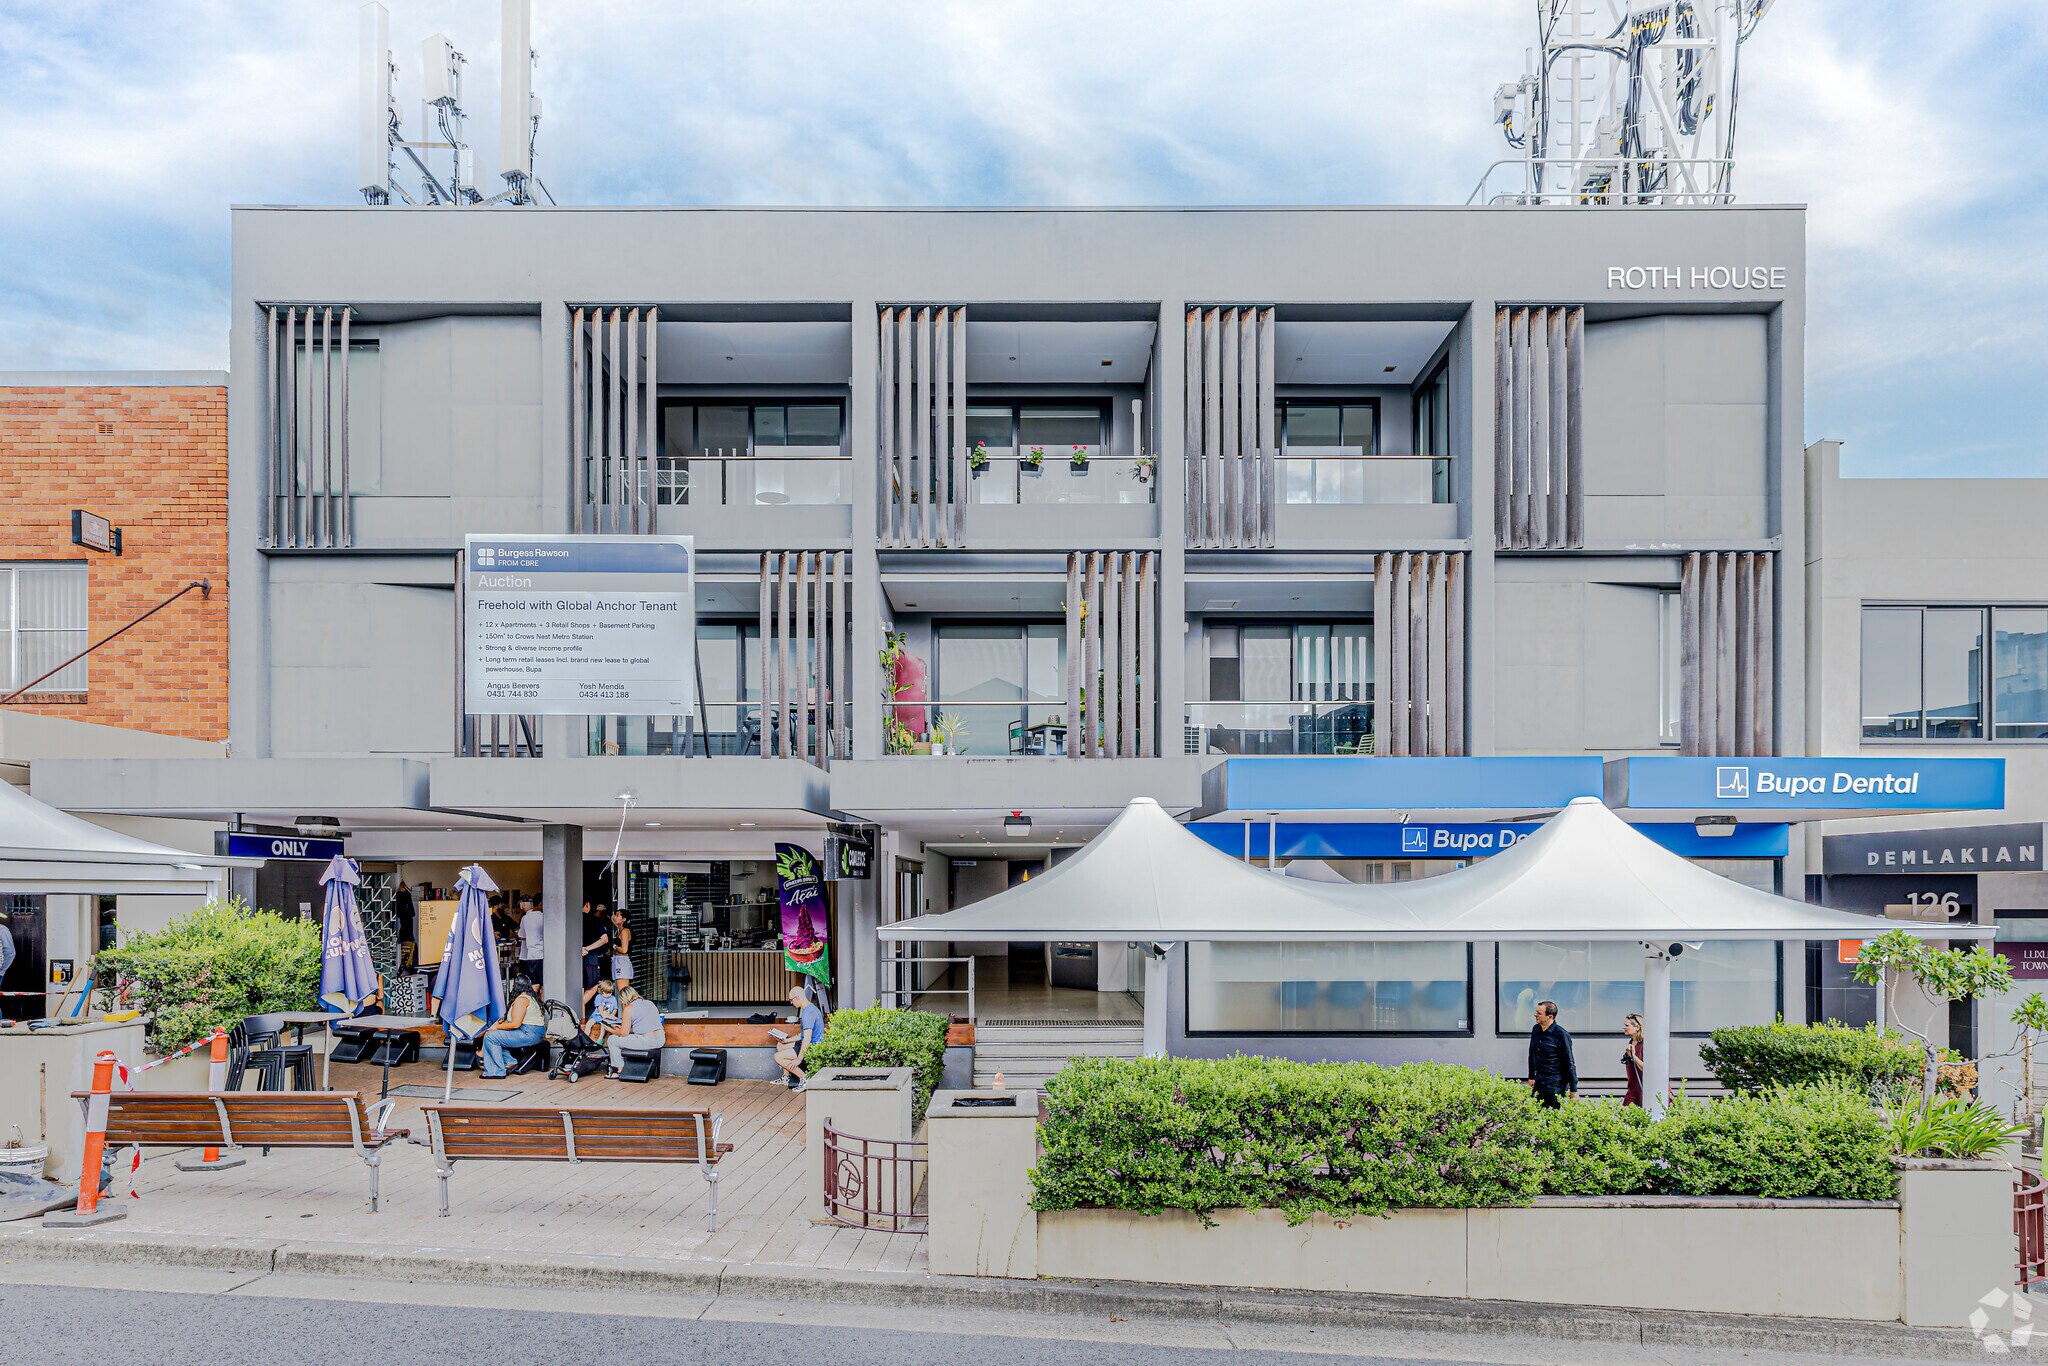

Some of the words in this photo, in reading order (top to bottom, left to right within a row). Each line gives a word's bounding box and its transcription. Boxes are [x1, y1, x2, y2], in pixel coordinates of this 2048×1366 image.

[1607, 266, 1681, 289] ROTH
[1690, 266, 1786, 289] HOUSE
[498, 548, 534, 559] Burgess
[535, 548, 569, 557] Rawson
[498, 559, 518, 567] FROM
[520, 559, 539, 567] CBRE
[478, 575, 531, 588] Auction
[478, 600, 525, 610] Freehold
[529, 600, 552, 610] with
[556, 600, 591, 611] Global
[596, 600, 636, 611] Anchor
[639, 600, 677, 611] Tenant
[500, 622, 536, 630] Apartments
[570, 622, 590, 630] Shops
[632, 622, 655, 631] Parking
[515, 632, 534, 640] Crows
[485, 644, 506, 653] Strong
[507, 644, 513, 652] &
[514, 644, 537, 652] diverse
[538, 644, 562, 652] income
[563, 644, 583, 653] profile
[485, 656, 501, 665] Long
[570, 656, 589, 664] brand
[630, 657, 649, 666] global
[485, 666, 524, 674] powerhouse,
[525, 666, 542, 674] Bupa
[487, 682, 511, 690] Angus
[579, 682, 597, 690] Yosh
[598, 682, 625, 690] Mendis
[486, 690, 506, 698] 0431
[507, 690, 522, 698] 744
[523, 690, 538, 698] 830
[579, 691, 599, 699] 0434
[615, 691, 630, 699] 188
[1756, 772, 1826, 797] Bupa
[1832, 772, 1919, 794] Dental
[1433, 829, 1493, 852] Bupa
[271, 839, 309, 857] ONLY
[1867, 845, 2035, 866] DEMLAKIAN
[1906, 892, 1961, 917] 126
